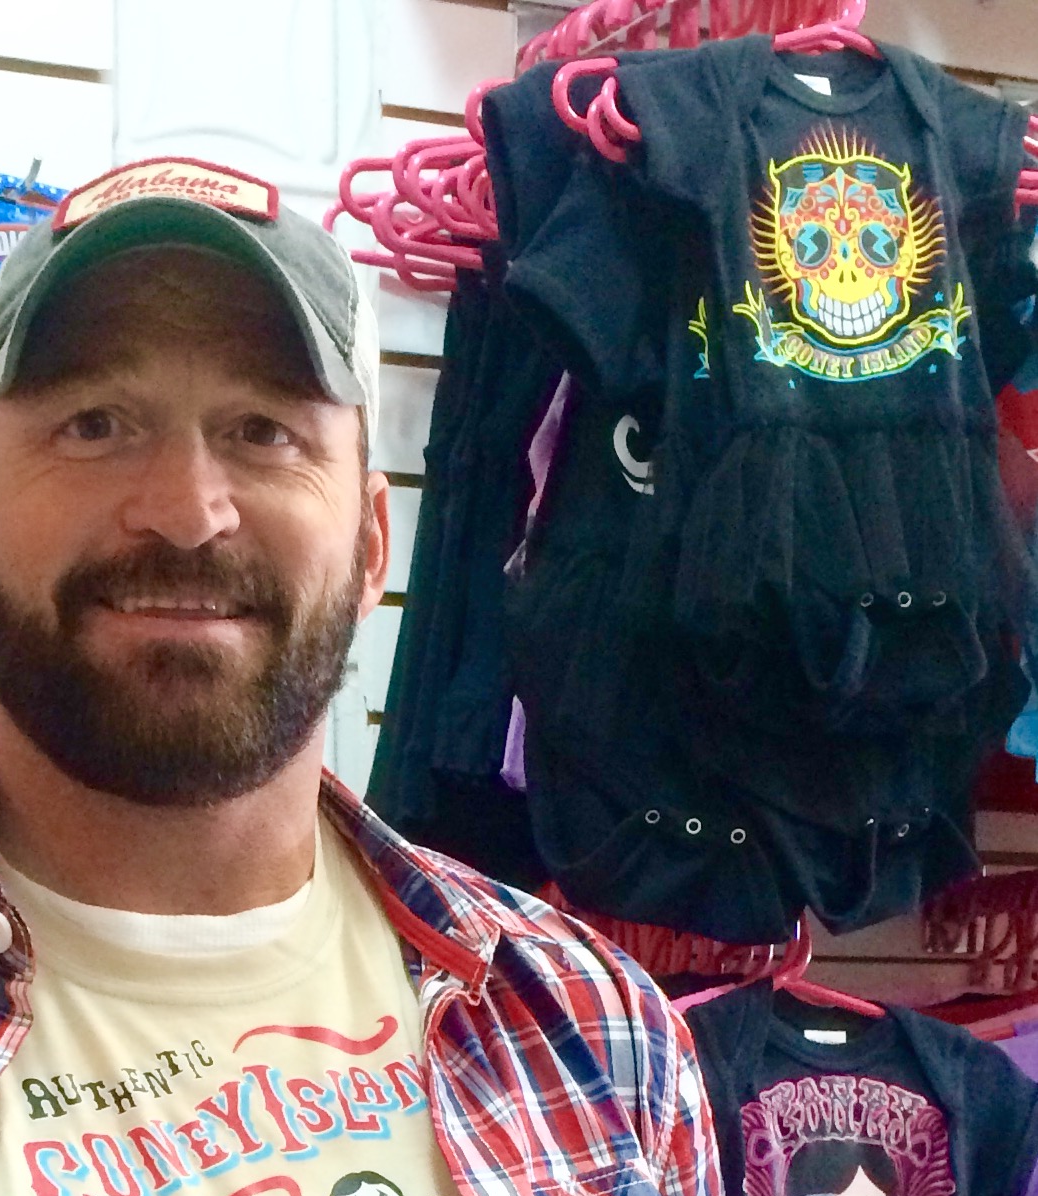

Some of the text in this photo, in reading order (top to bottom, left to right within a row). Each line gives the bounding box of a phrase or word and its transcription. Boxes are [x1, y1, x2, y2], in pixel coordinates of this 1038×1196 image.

[84, 168, 239, 207] Alabama
[784, 327, 932, 377] CONEY ISLAND
[21, 1039, 214, 1120] AUTHENTIC
[240, 1053, 430, 1160] ISLAN
